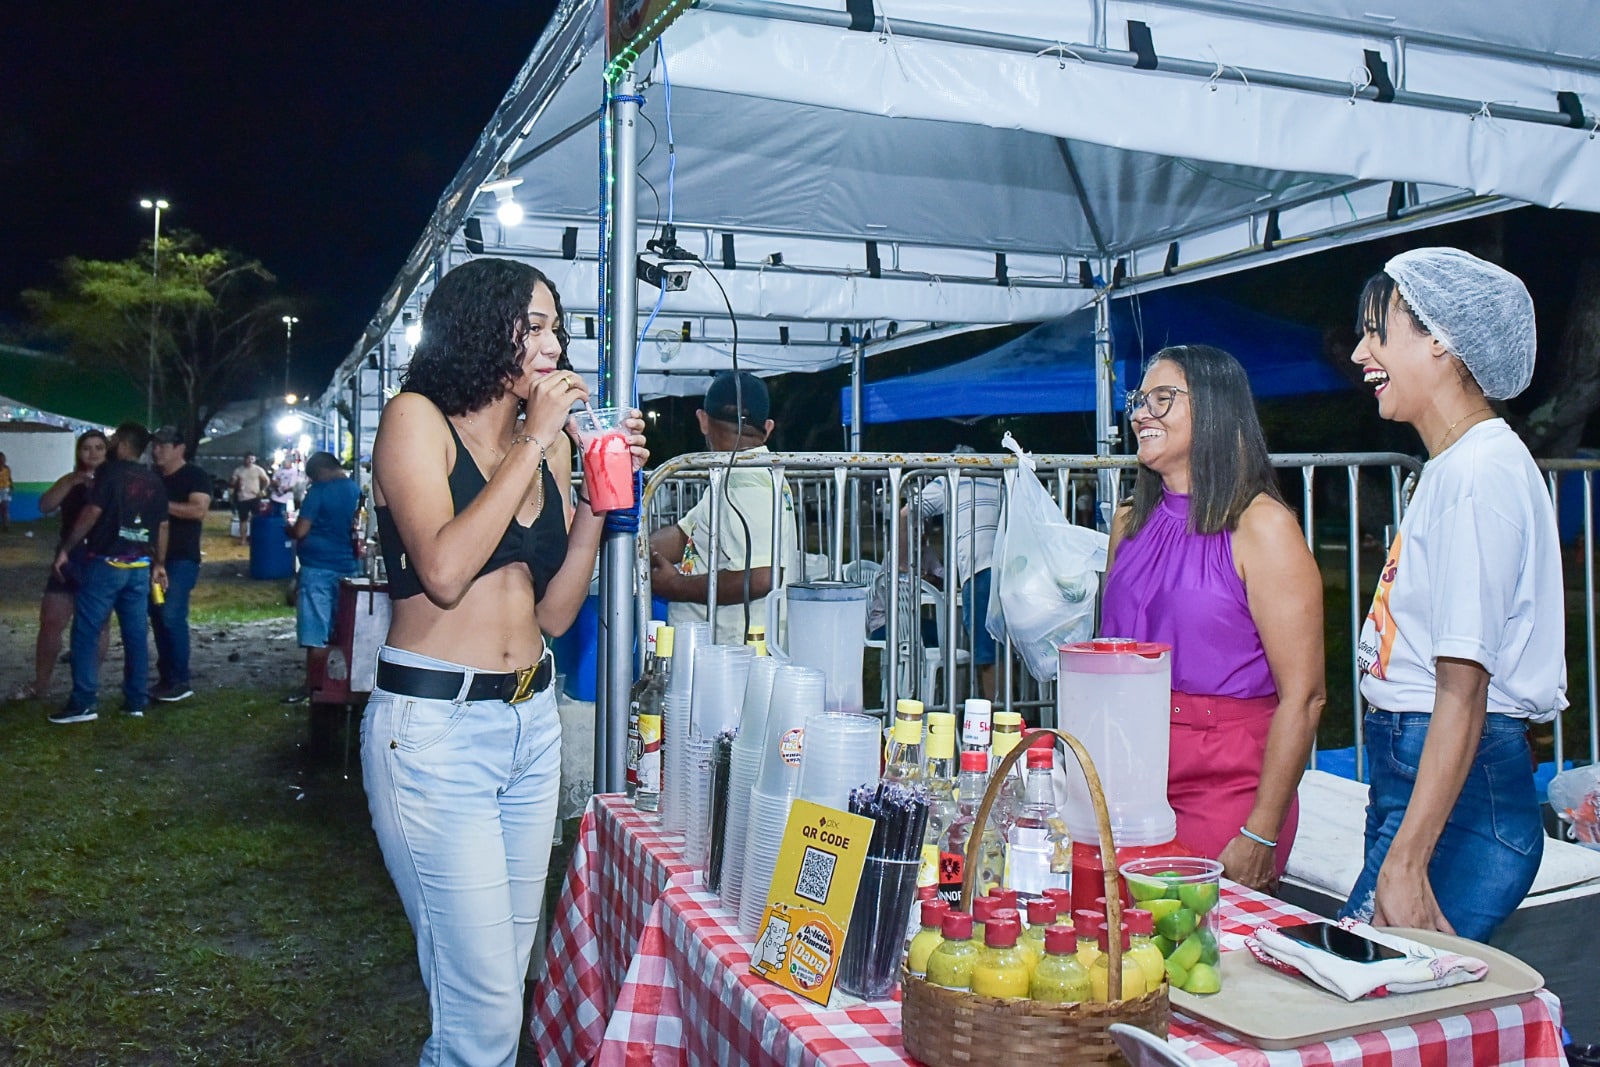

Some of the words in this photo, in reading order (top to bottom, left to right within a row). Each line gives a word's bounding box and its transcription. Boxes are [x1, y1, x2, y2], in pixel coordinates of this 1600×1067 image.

[802, 825, 818, 840] QR
[820, 831, 850, 850] CODE
[802, 934, 834, 956] Pimentas
